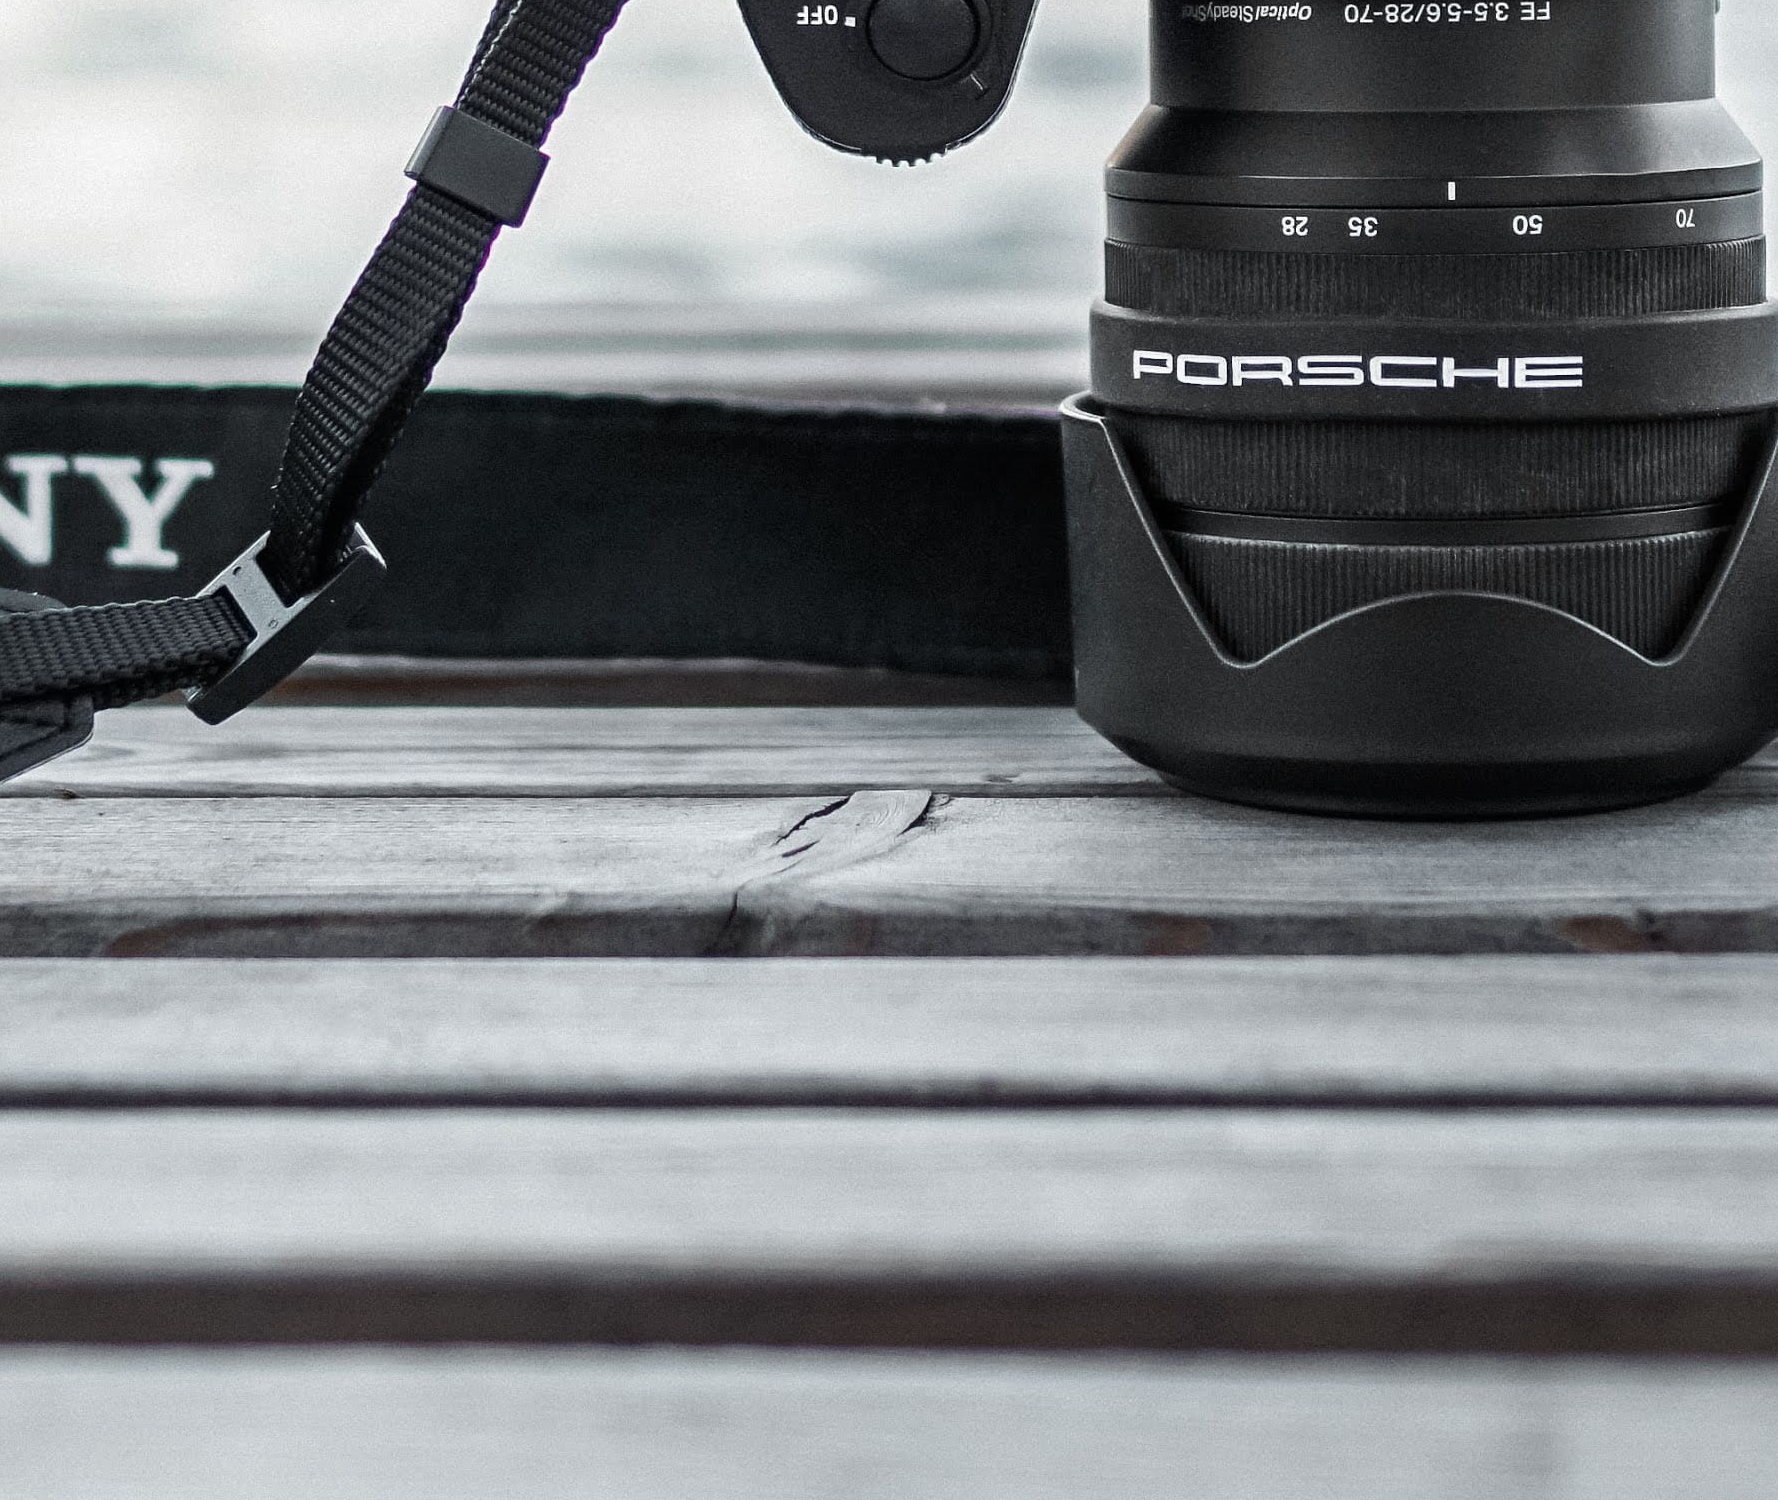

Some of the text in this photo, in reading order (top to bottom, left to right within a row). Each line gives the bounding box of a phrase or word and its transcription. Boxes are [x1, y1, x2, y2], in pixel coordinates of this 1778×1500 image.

[796, 5, 839, 25] OFF
[1344, 1, 1551, 23] FE 3.5-5.6/28-70
[1281, 215, 1310, 236] 28
[1348, 215, 1379, 237] 35
[1512, 214, 1544, 235] 50
[1675, 208, 1696, 229] 70
[1132, 349, 1584, 388] PORSCHE
